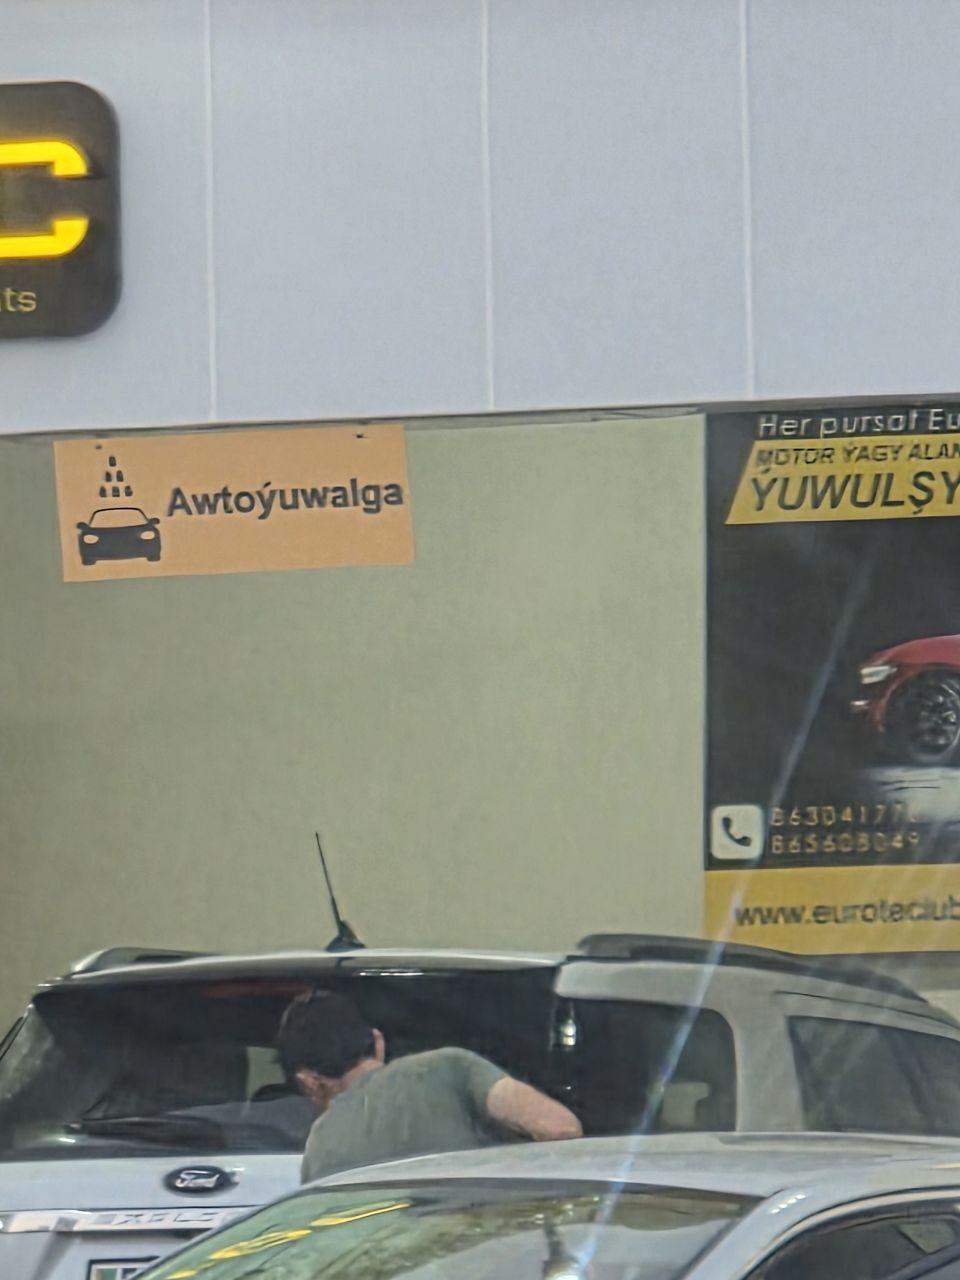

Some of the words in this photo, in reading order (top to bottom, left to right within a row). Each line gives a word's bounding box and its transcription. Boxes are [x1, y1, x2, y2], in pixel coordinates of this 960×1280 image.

[759, 413, 812, 438] Her
[755, 447, 836, 466] MOTOR
[167, 477, 404, 520] Awtoýuwalga
